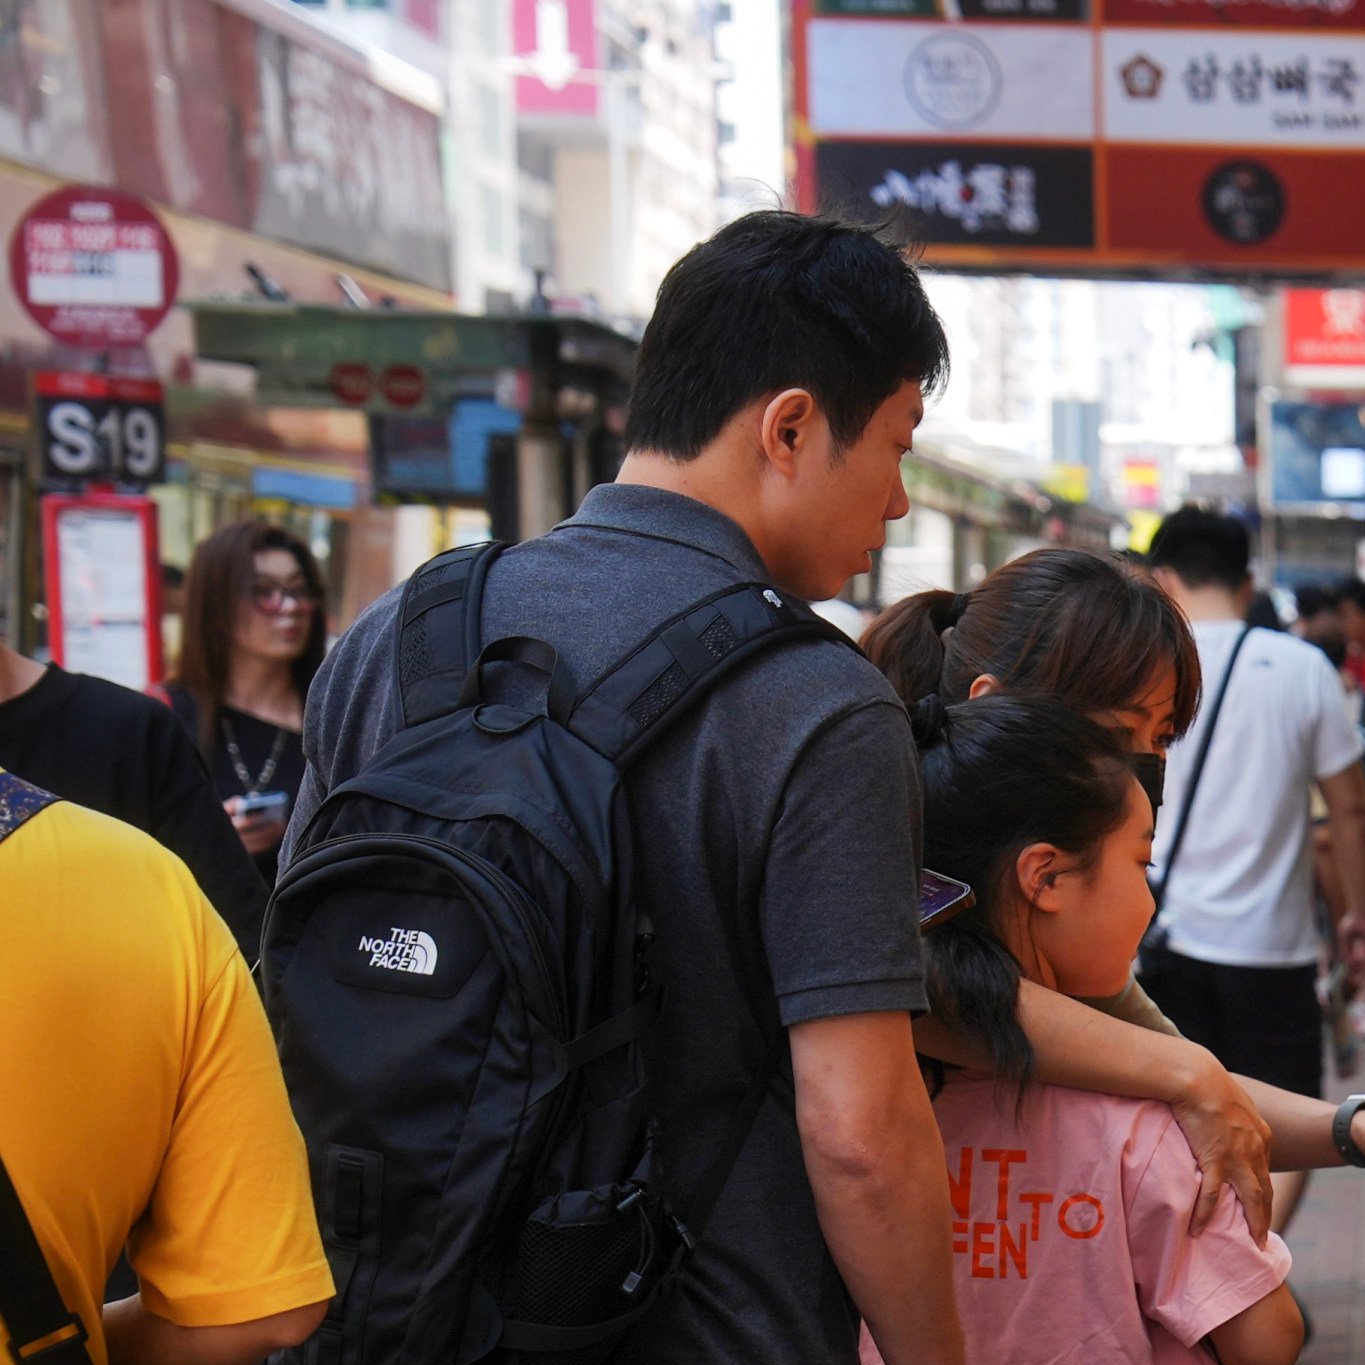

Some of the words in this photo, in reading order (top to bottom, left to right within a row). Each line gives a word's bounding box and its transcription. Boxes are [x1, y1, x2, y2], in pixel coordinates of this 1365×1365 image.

[48, 401, 159, 477] S19
[358, 936, 416, 958] NORTH
[390, 927, 419, 945] THE
[369, 953, 411, 971] FACE
[1019, 1192, 1105, 1241] TO
